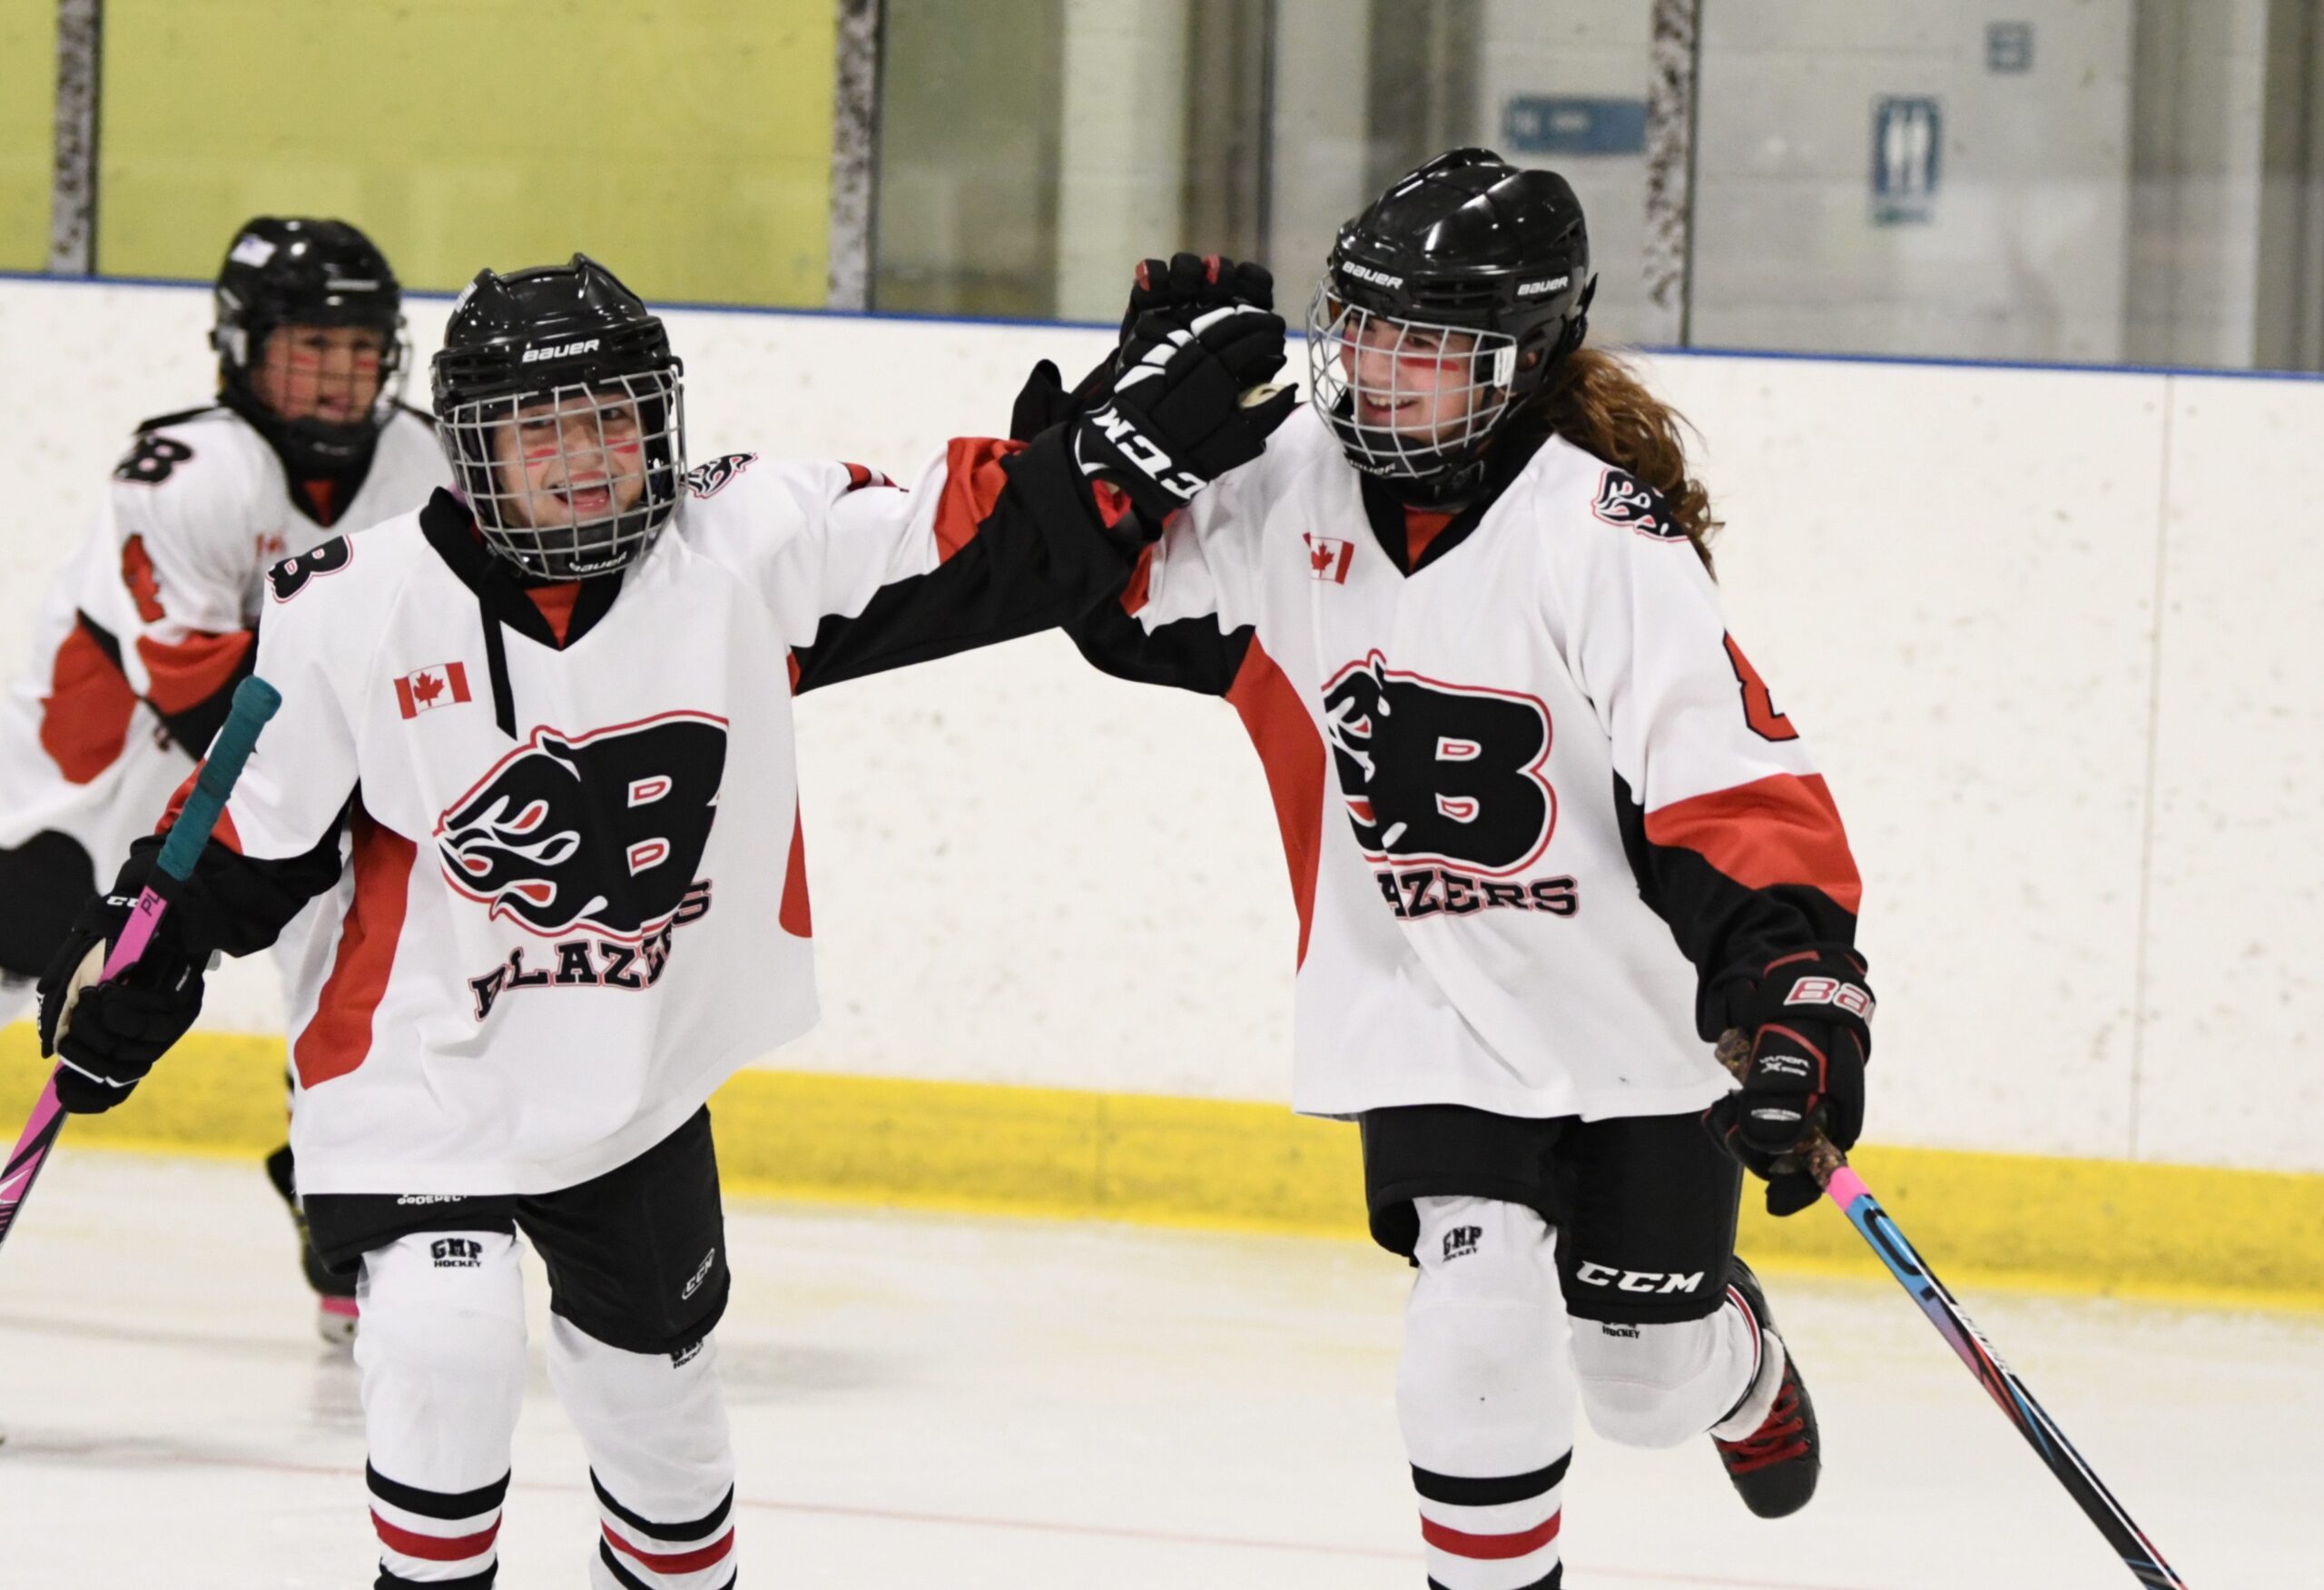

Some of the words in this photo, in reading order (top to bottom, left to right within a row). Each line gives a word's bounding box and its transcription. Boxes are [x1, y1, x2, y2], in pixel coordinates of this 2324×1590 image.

[1092, 407, 1208, 499] CCM
[433, 1259, 482, 1269] HOCKEY
[1576, 1259, 1706, 1294] CCM
